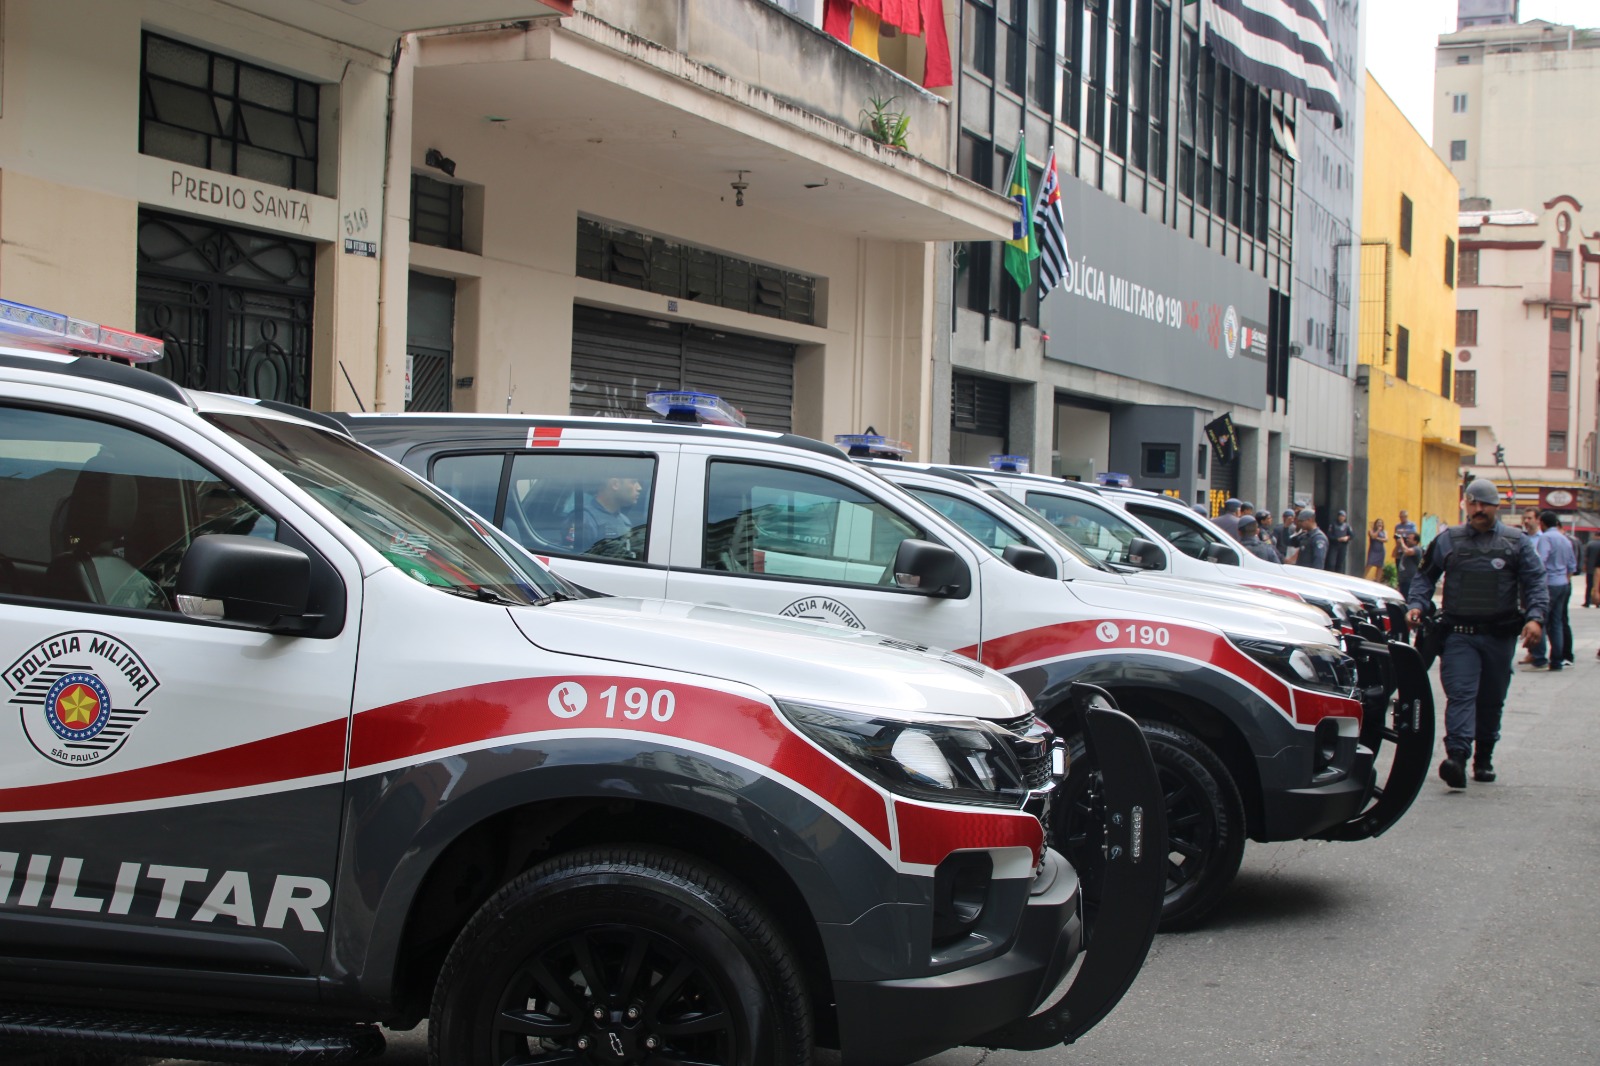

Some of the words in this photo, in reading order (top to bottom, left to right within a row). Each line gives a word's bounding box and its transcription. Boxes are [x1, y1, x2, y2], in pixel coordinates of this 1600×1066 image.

[171, 170, 246, 210] PREDIO
[252, 190, 310, 223] SANTA
[344, 207, 368, 236] 510
[1056, 255, 1106, 304] OLÍCIA
[1109, 274, 1155, 321] MILITAR
[1165, 296, 1182, 329] 190
[784, 600, 817, 617] LÍCIA
[1125, 624, 1170, 647] 190
[12, 636, 81, 685] POLÍCIA
[89, 637, 150, 692] MILITAR
[600, 685, 676, 722] 190
[51, 748, 69, 760] SÃO
[70, 750, 100, 762] PAULO
